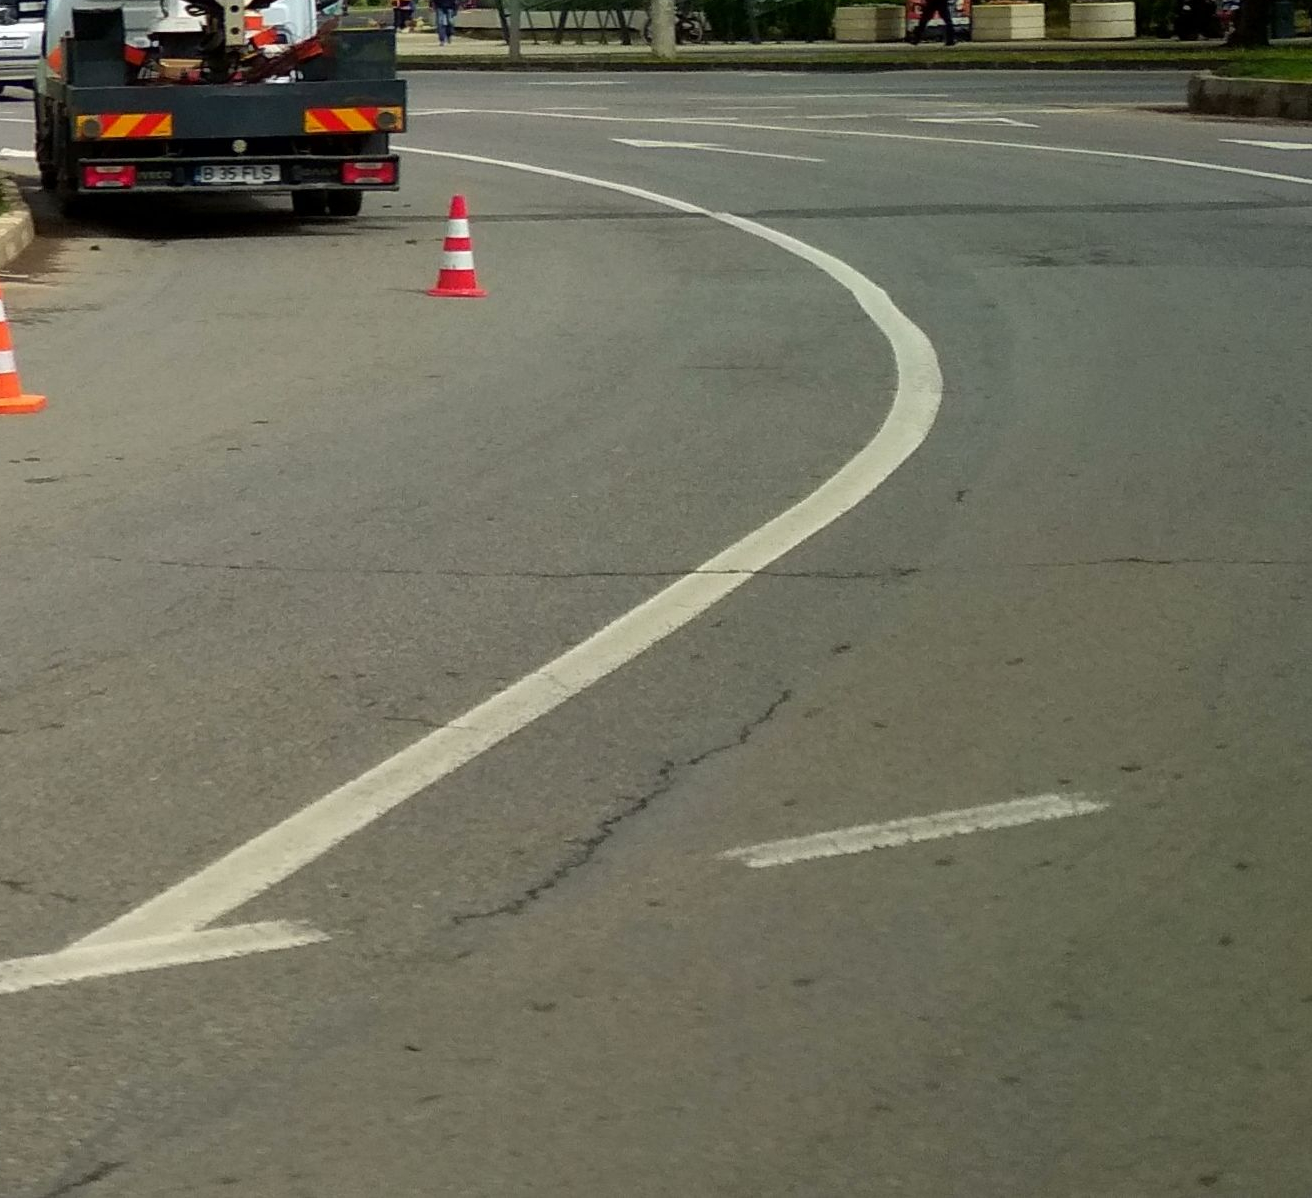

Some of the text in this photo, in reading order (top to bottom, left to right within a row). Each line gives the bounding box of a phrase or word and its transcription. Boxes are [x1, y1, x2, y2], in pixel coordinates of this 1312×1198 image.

[203, 166, 273, 180] B 35 FLS
